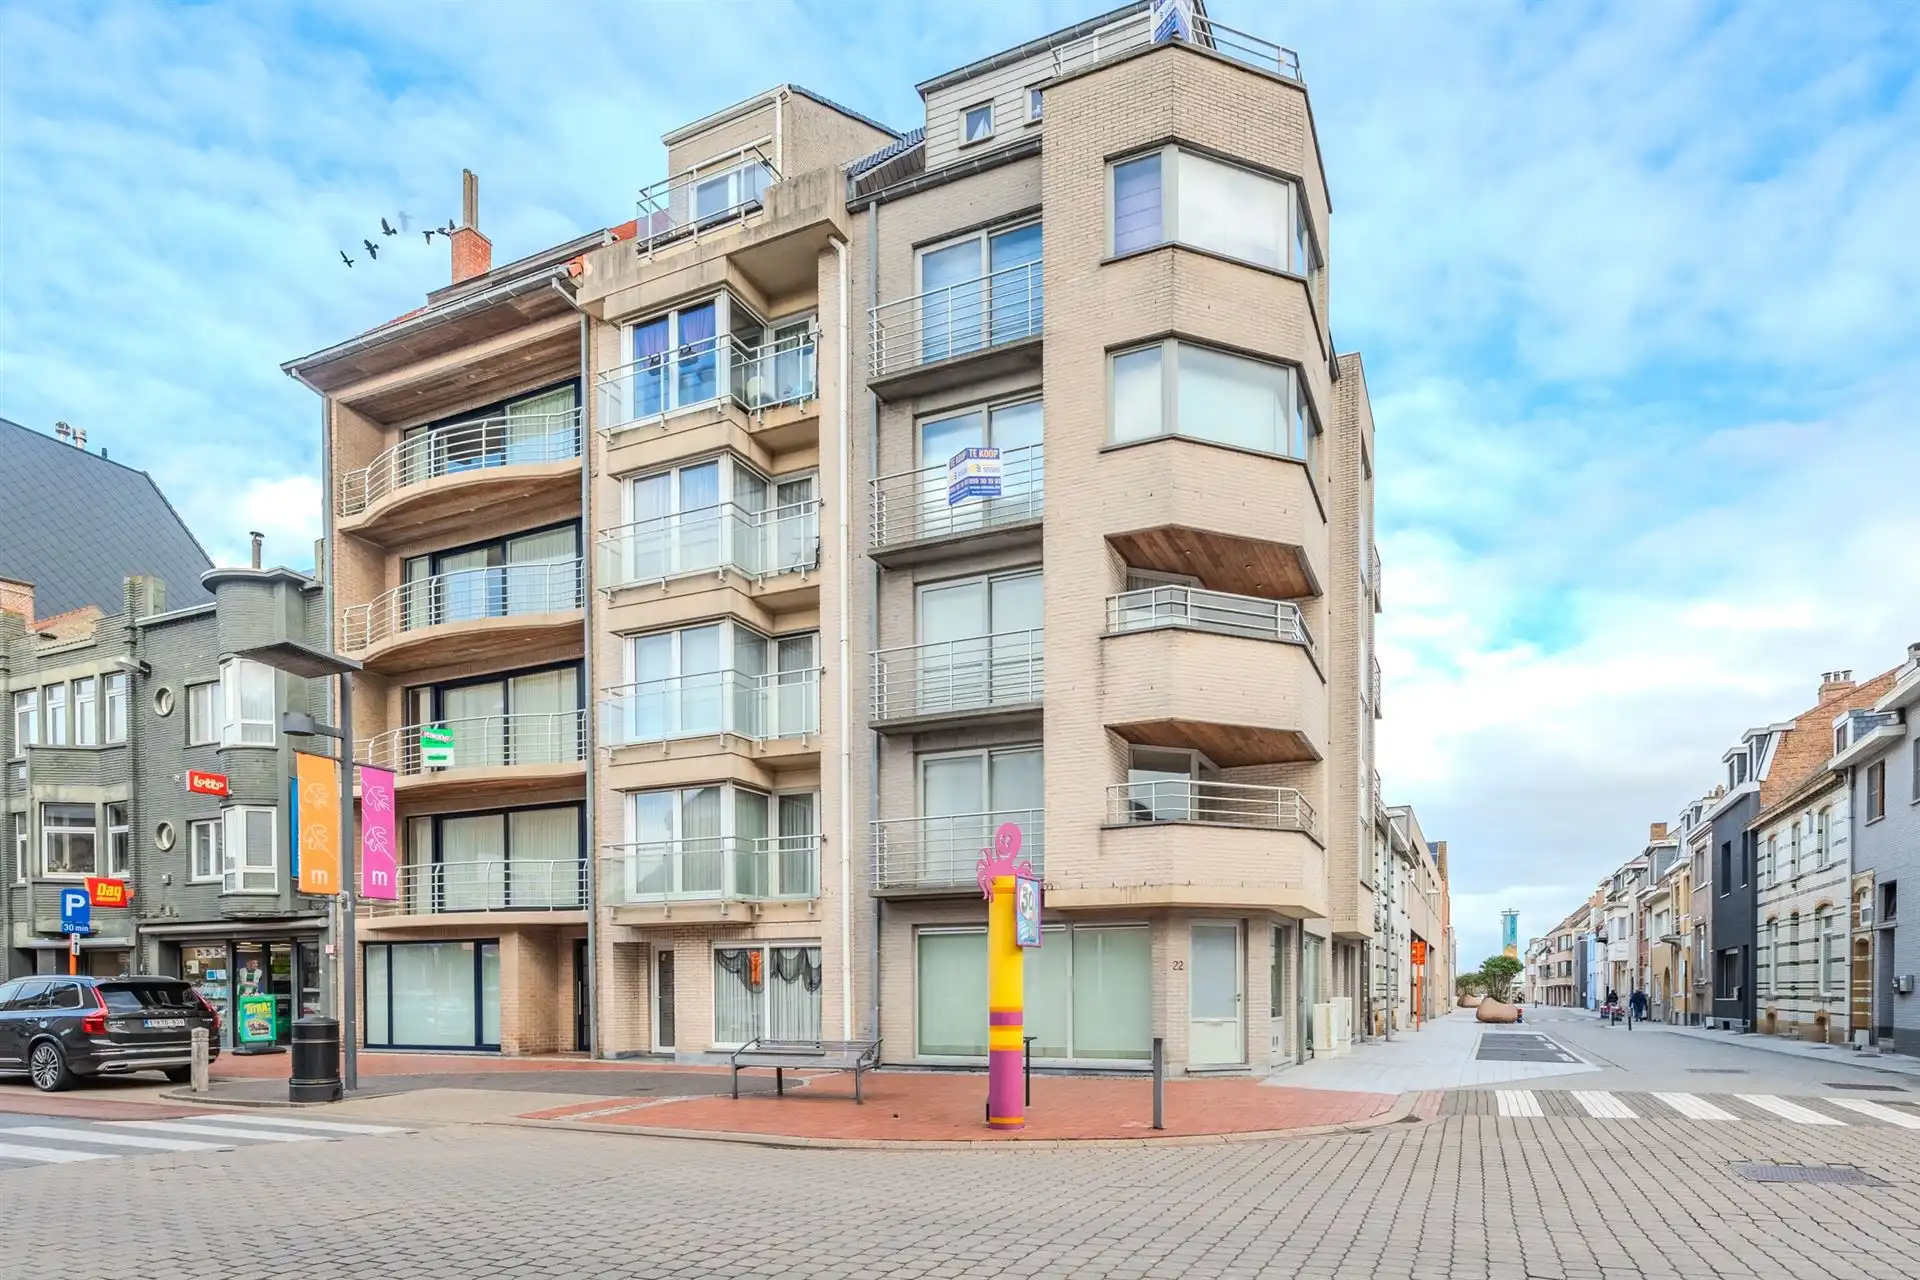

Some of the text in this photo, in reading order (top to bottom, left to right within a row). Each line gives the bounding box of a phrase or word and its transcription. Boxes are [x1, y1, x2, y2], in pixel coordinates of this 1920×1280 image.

[968, 448, 998, 458] TE KOOP
[97, 882, 122, 902] Dag
[66, 894, 86, 917] P
[63, 923, 89, 932] 30 min
[1172, 960, 1184, 971] 22
